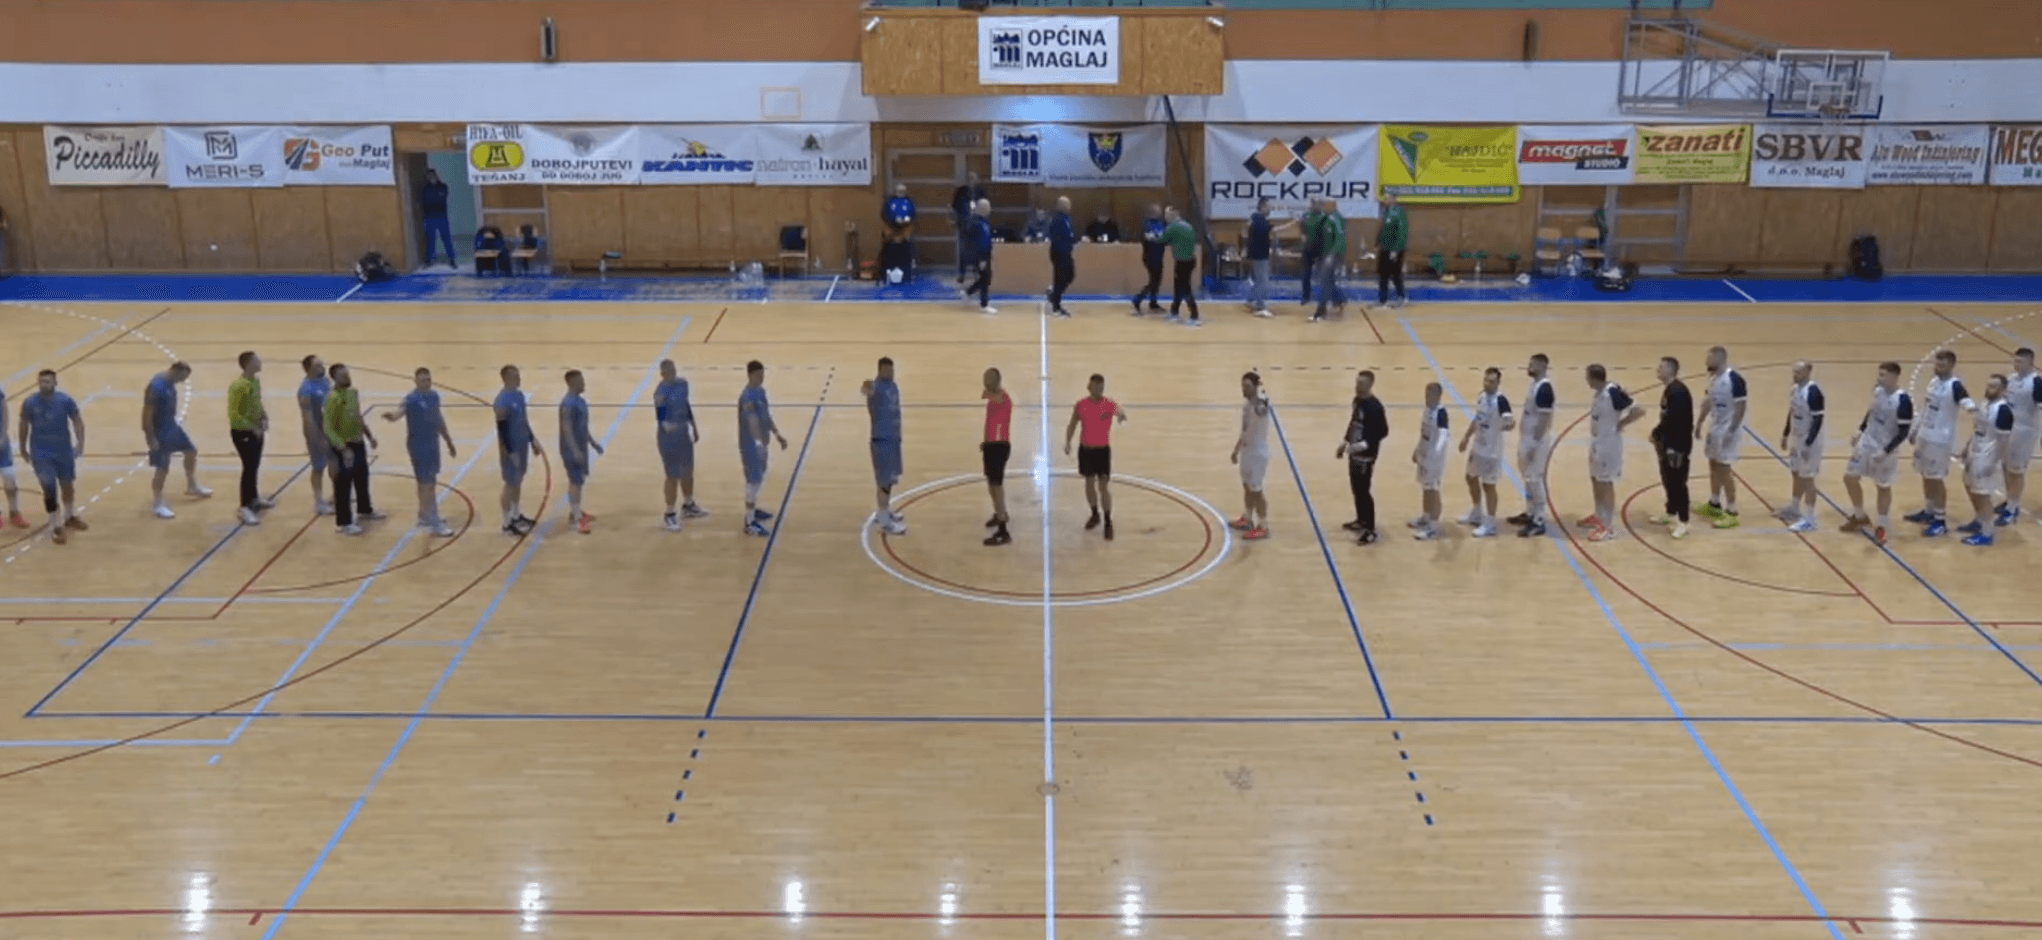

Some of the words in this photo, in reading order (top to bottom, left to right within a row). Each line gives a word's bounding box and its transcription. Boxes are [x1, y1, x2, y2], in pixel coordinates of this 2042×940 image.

[1027, 24, 1106, 47] OPĆINA
[1026, 51, 1107, 68] MAGLAJ
[321, 144, 354, 157] Geo
[361, 144, 389, 157] Put
[1528, 141, 1617, 159] magnet
[1755, 133, 1863, 161] SBVR
[53, 135, 160, 179] Piccadilly
[531, 159, 633, 170] DOBOJPUTEVI
[1584, 159, 1620, 169] STUDIO
[186, 164, 264, 178] MERI-S
[1804, 166, 1845, 178] Maglaj
[1210, 181, 1370, 199] ROCKPUR
